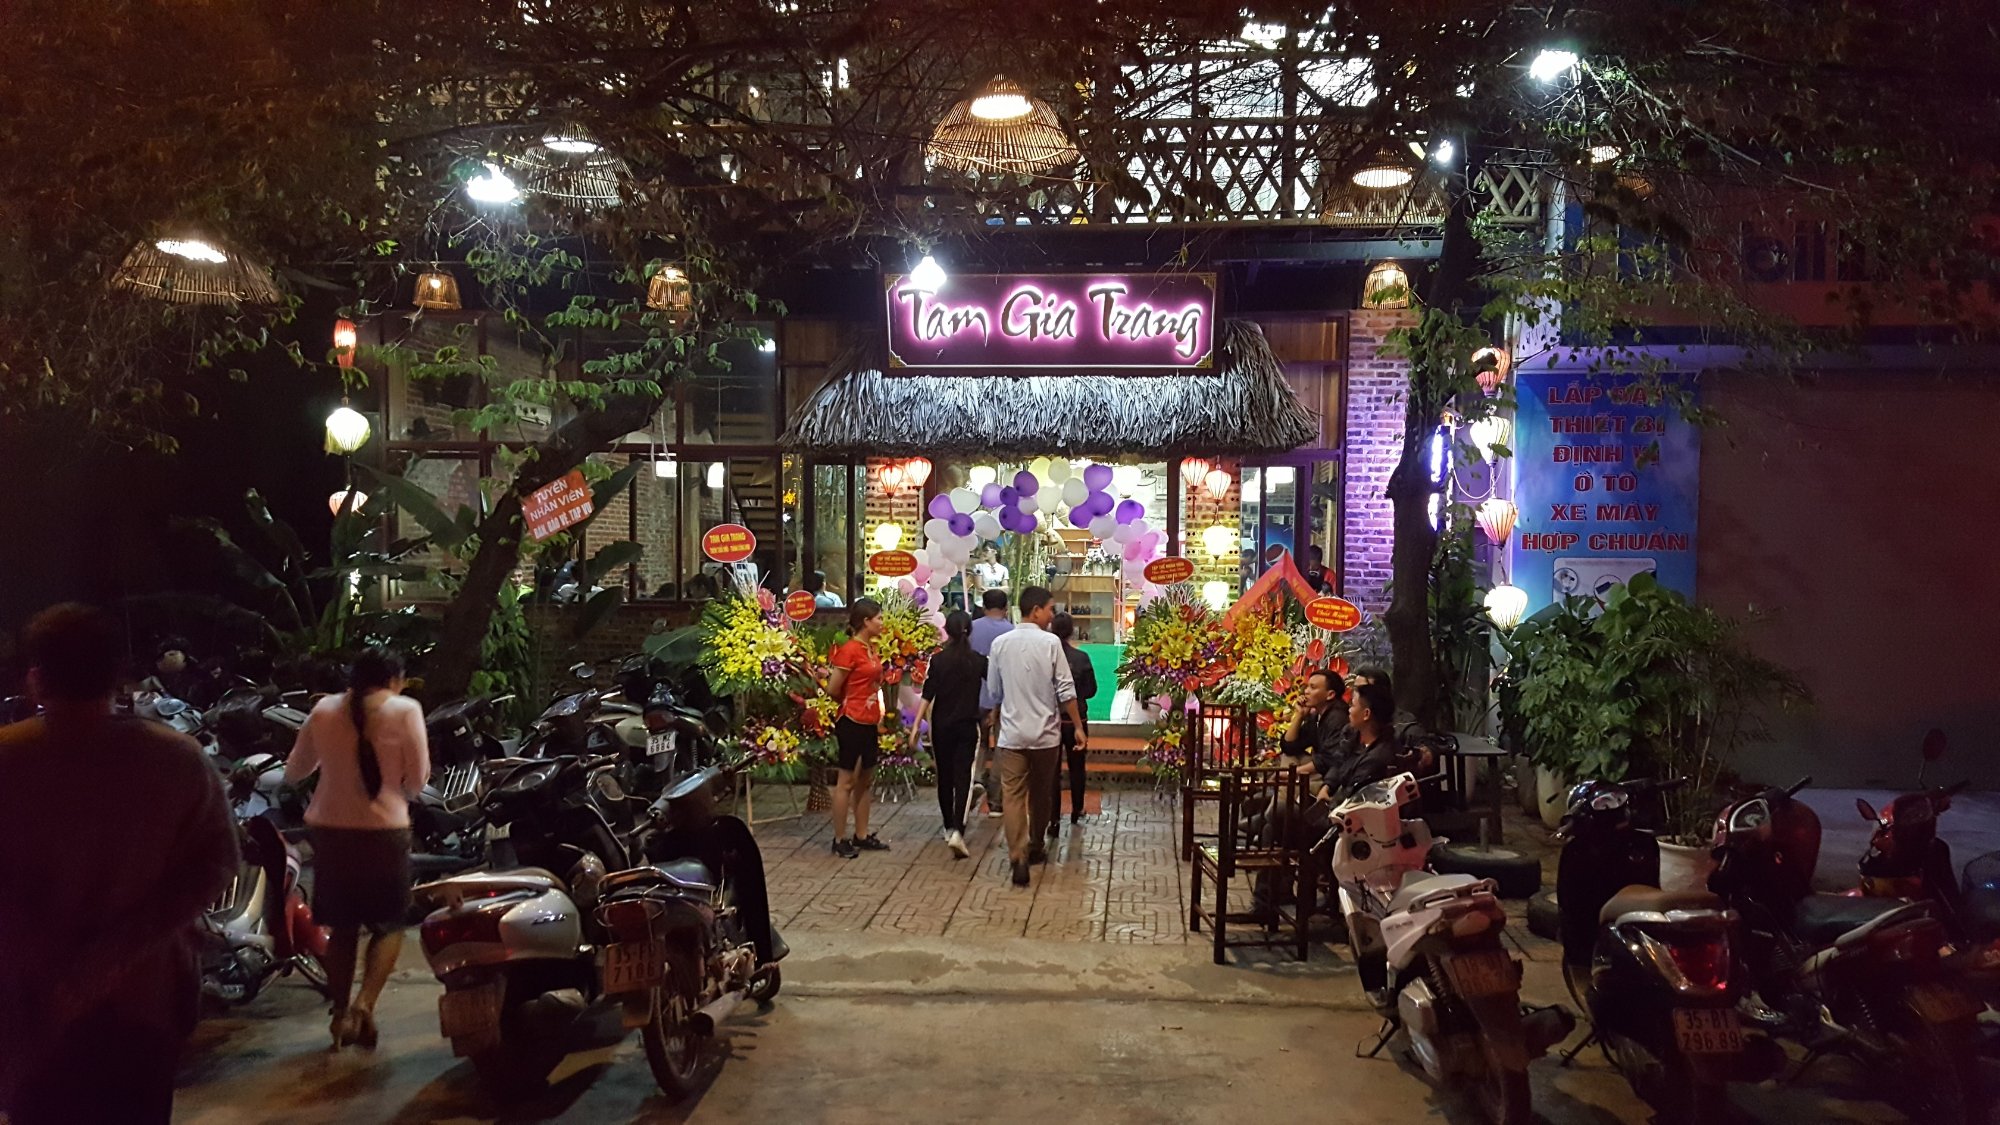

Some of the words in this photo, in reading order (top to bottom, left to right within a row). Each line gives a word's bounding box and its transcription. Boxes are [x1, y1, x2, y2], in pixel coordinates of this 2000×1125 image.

[898, 286, 990, 347] Tam
[1001, 287, 1076, 341] Gia
[1088, 286, 1203, 358] Trang
[1552, 445, 1624, 467] ĐỊNH
[1602, 471, 1637, 493] TÔ
[557, 487, 585, 507] VIÊN
[1551, 503, 1588, 522] XE
[1596, 500, 1660, 522] MÁY
[1521, 530, 1580, 554] HỢP
